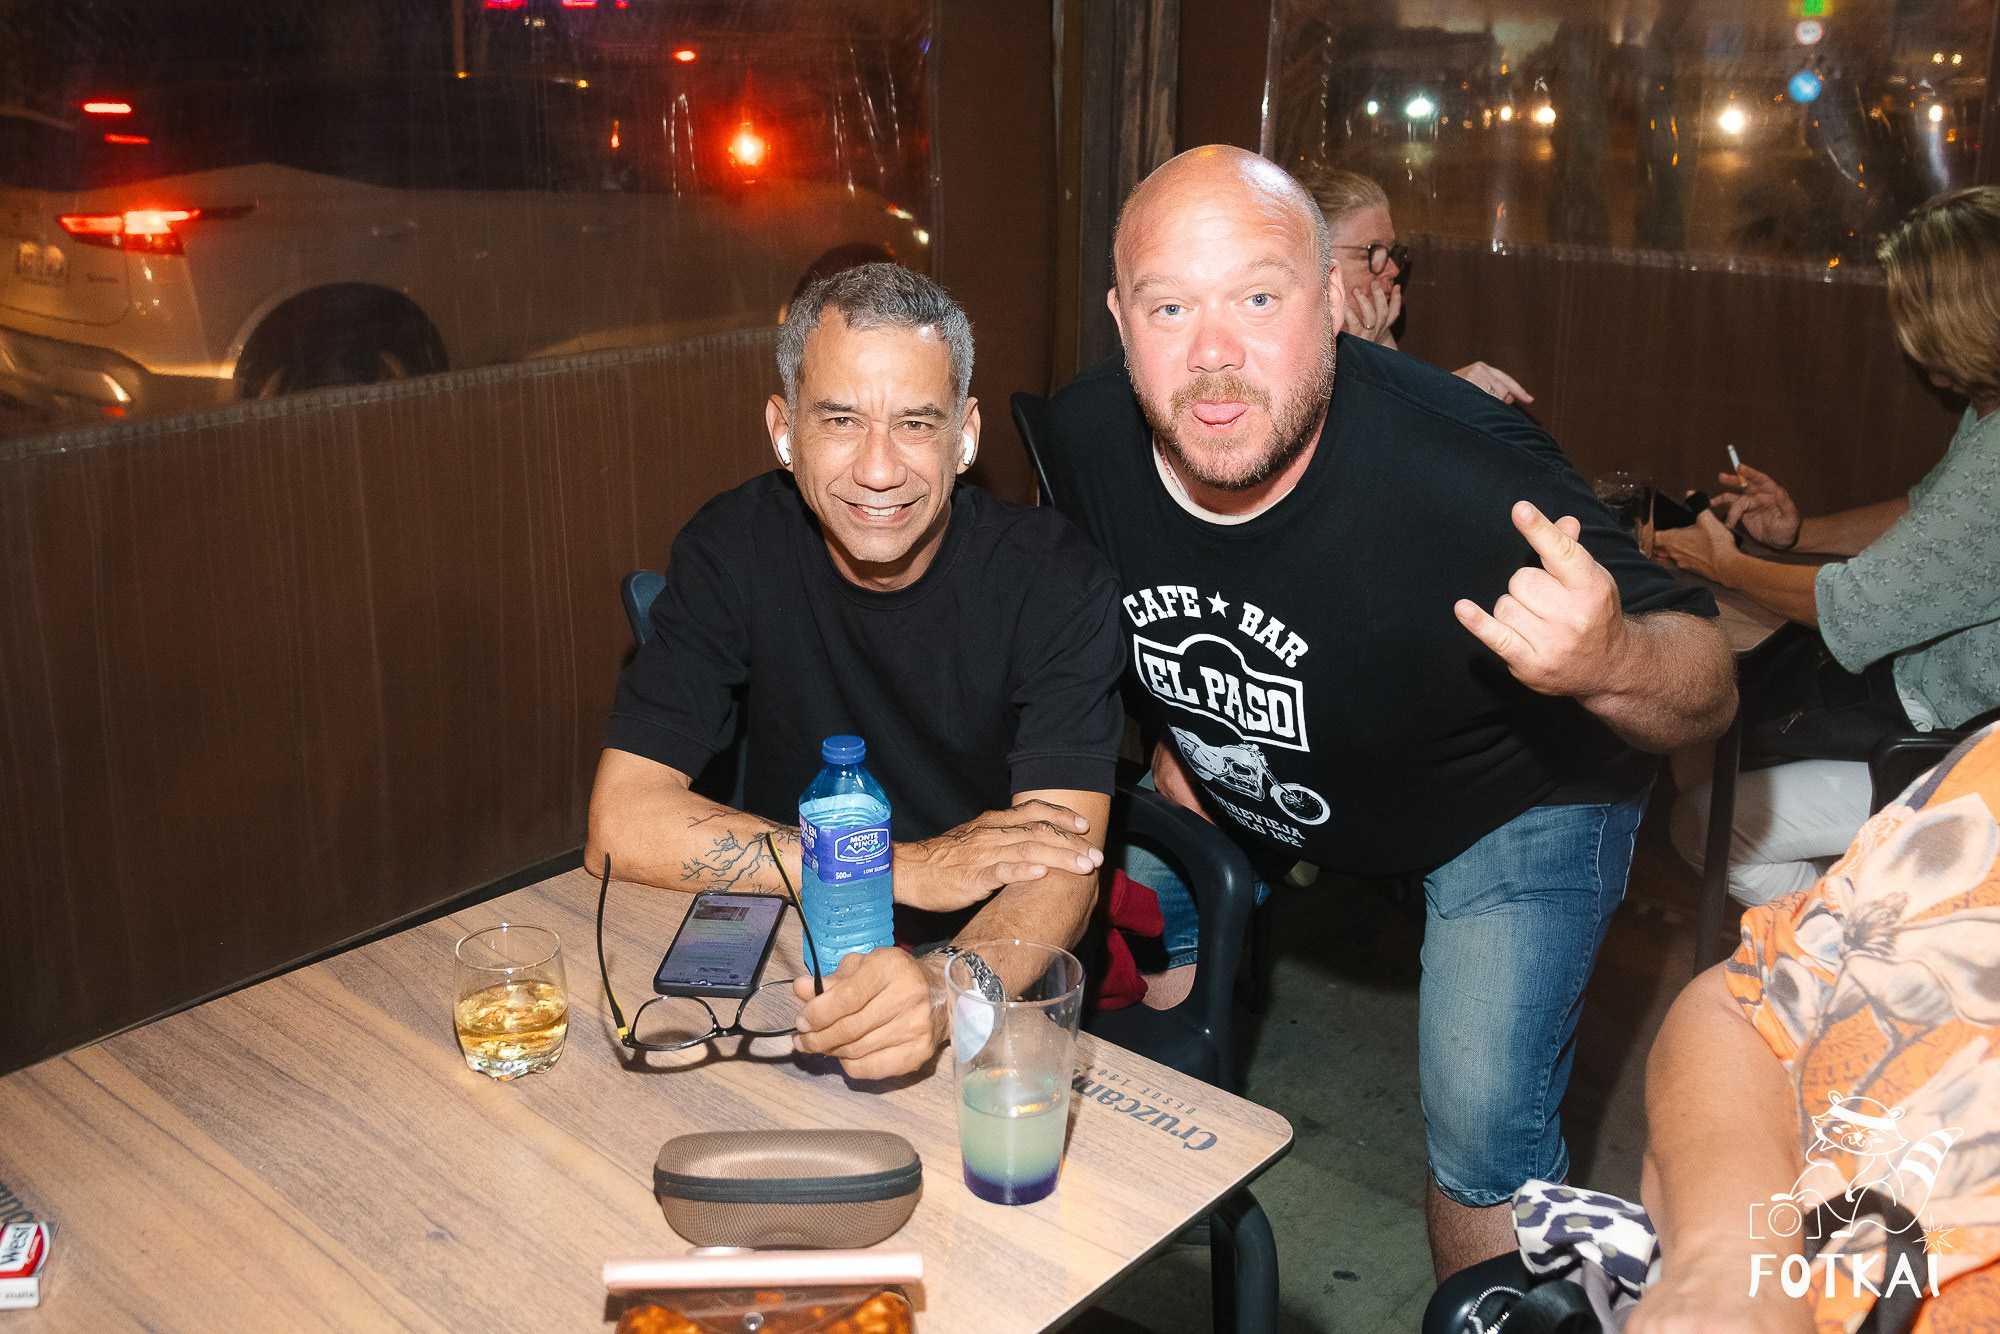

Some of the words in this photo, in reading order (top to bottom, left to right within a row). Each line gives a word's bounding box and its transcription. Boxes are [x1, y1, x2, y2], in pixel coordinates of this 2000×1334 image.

[1123, 585, 1201, 627] CAFE
[1238, 602, 1308, 668] BAR
[1143, 653, 1200, 705] EL
[1200, 666, 1295, 738] PASO
[850, 832, 879, 844] MONTE
[854, 839, 879, 848] PINOS
[1270, 829, 1302, 848] 102
[1140, 1088, 1197, 1115] DESDE
